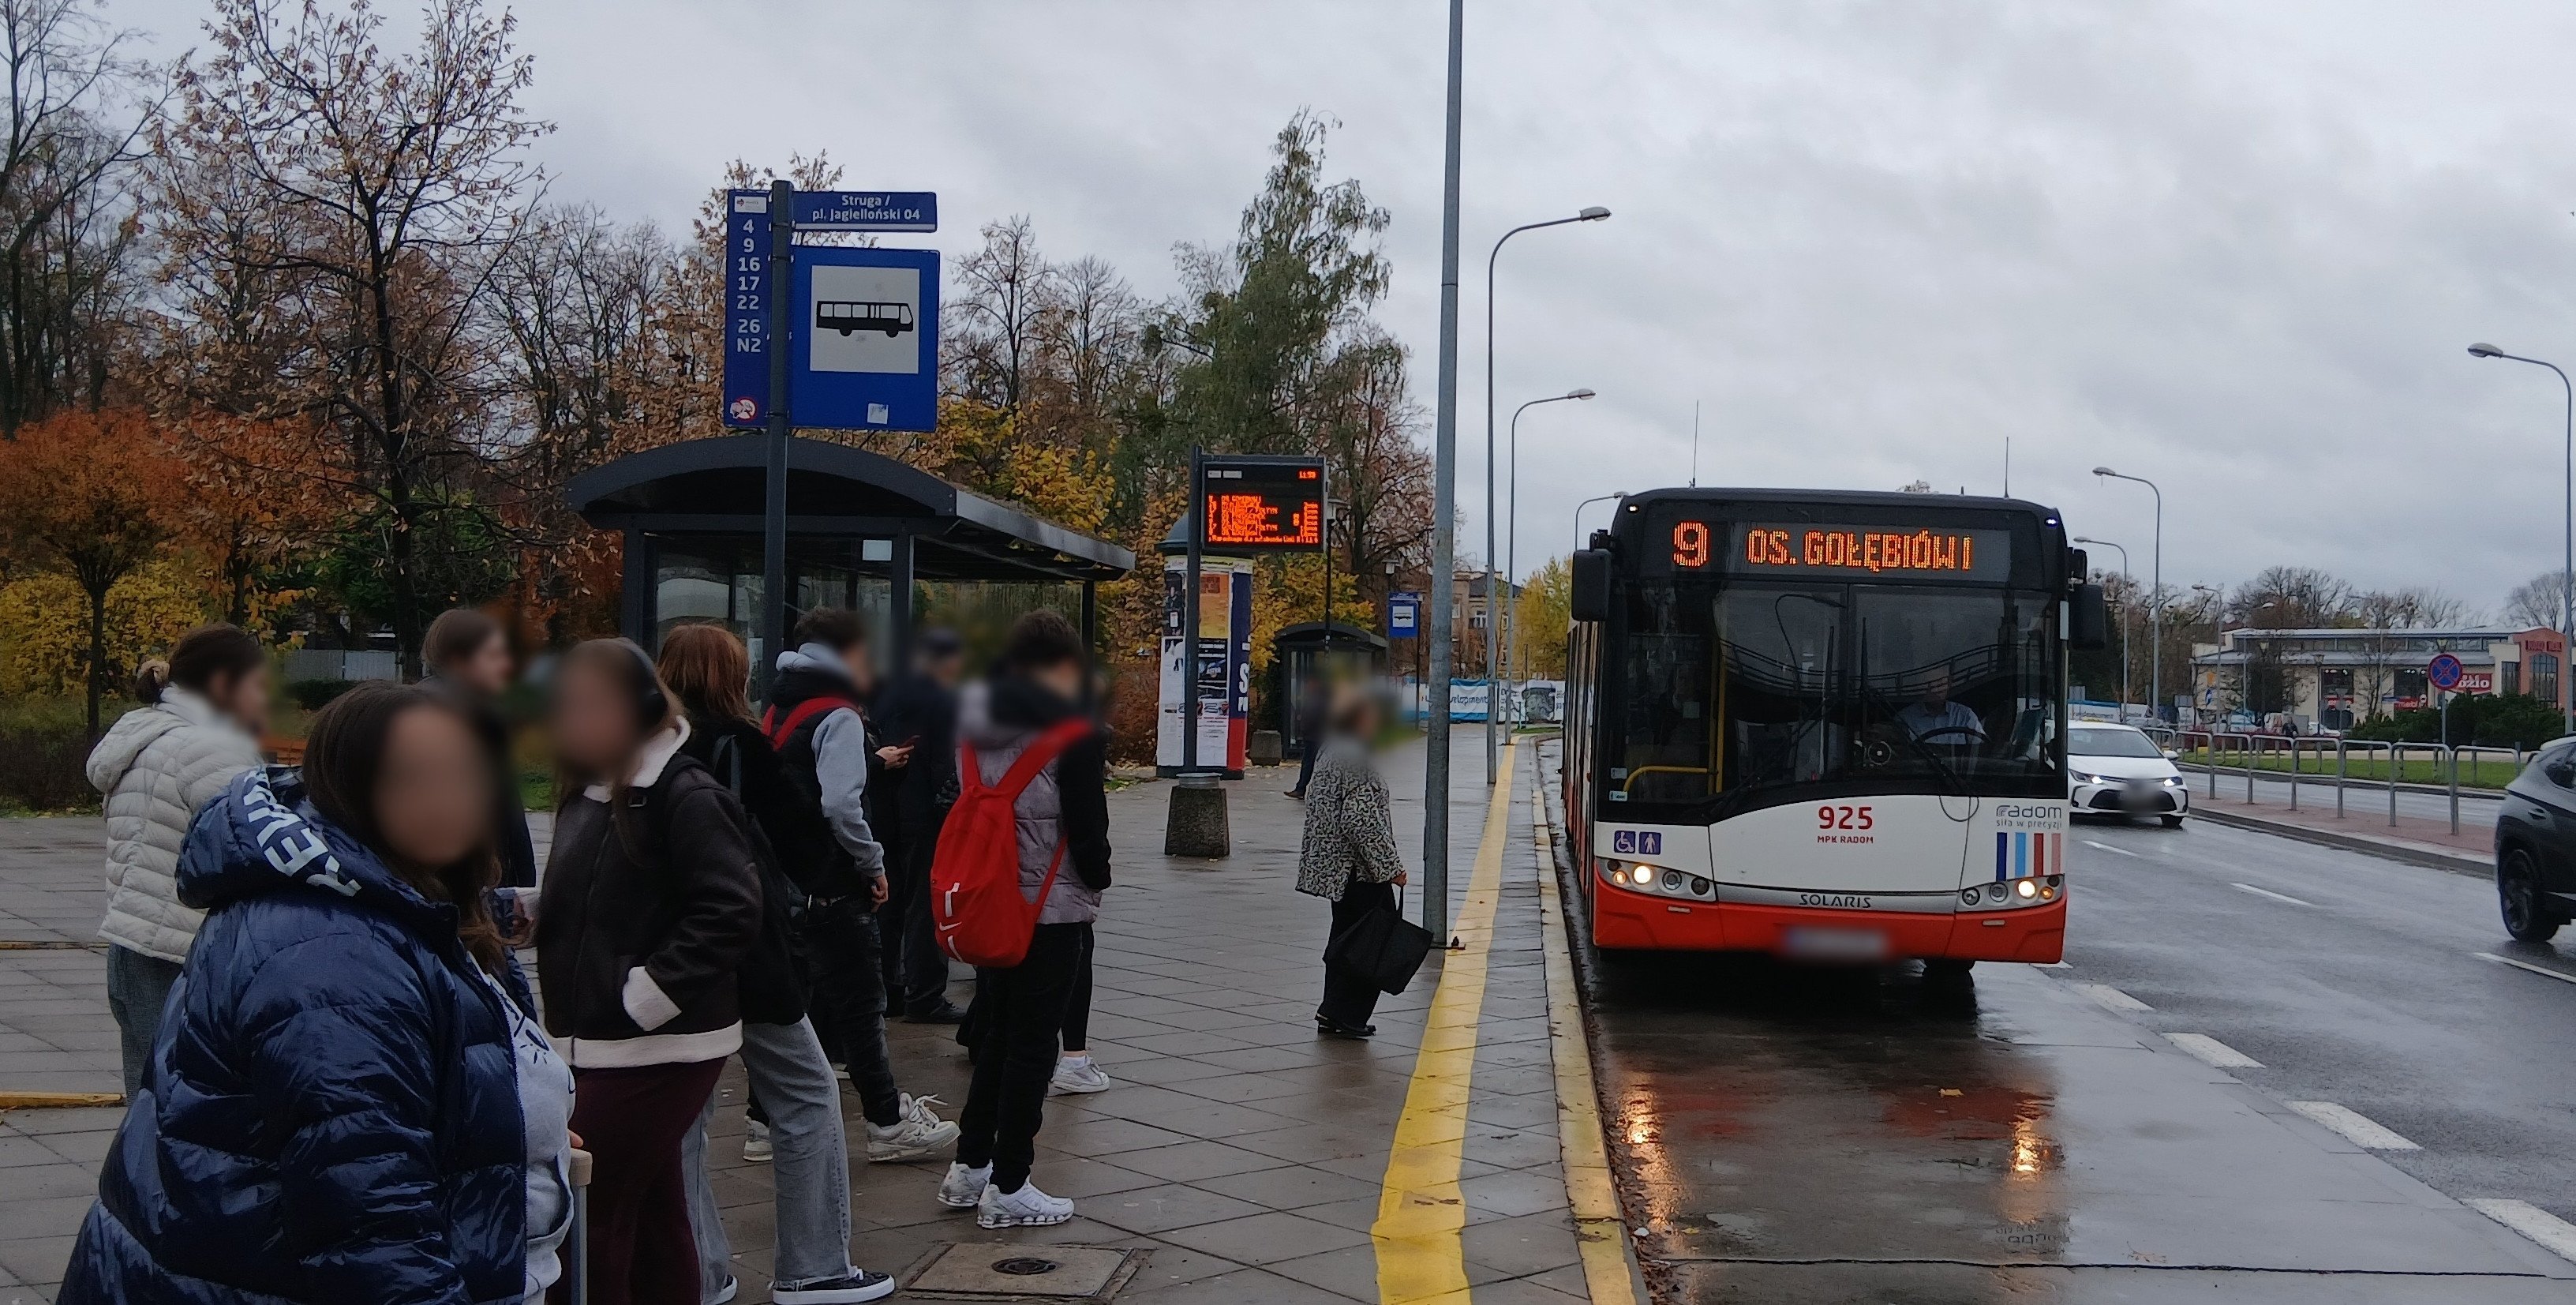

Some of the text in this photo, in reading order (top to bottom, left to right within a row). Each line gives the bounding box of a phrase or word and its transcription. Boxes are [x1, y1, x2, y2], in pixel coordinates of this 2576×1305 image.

[841, 194, 890, 208] Struga /
[829, 208, 900, 222] Jagielloński
[904, 208, 921, 220] 04
[743, 219, 754, 234] 4
[743, 238, 754, 253] 9
[738, 257, 761, 272] 16
[738, 276, 760, 291] 17
[736, 294, 759, 310] 22
[738, 319, 761, 334] 26
[736, 338, 762, 353] N2
[1672, 520, 1709, 568] 9
[1747, 529, 1798, 565] OS.
[1804, 530, 1956, 572] GOŁĘBIÓW
[1818, 806, 1873, 830] 925
[1996, 804, 2061, 819] radom
[2027, 819, 2062, 830] precyzji
[1817, 835, 1874, 845] MPK RADOM
[1799, 894, 1871, 909] SOLARIS
